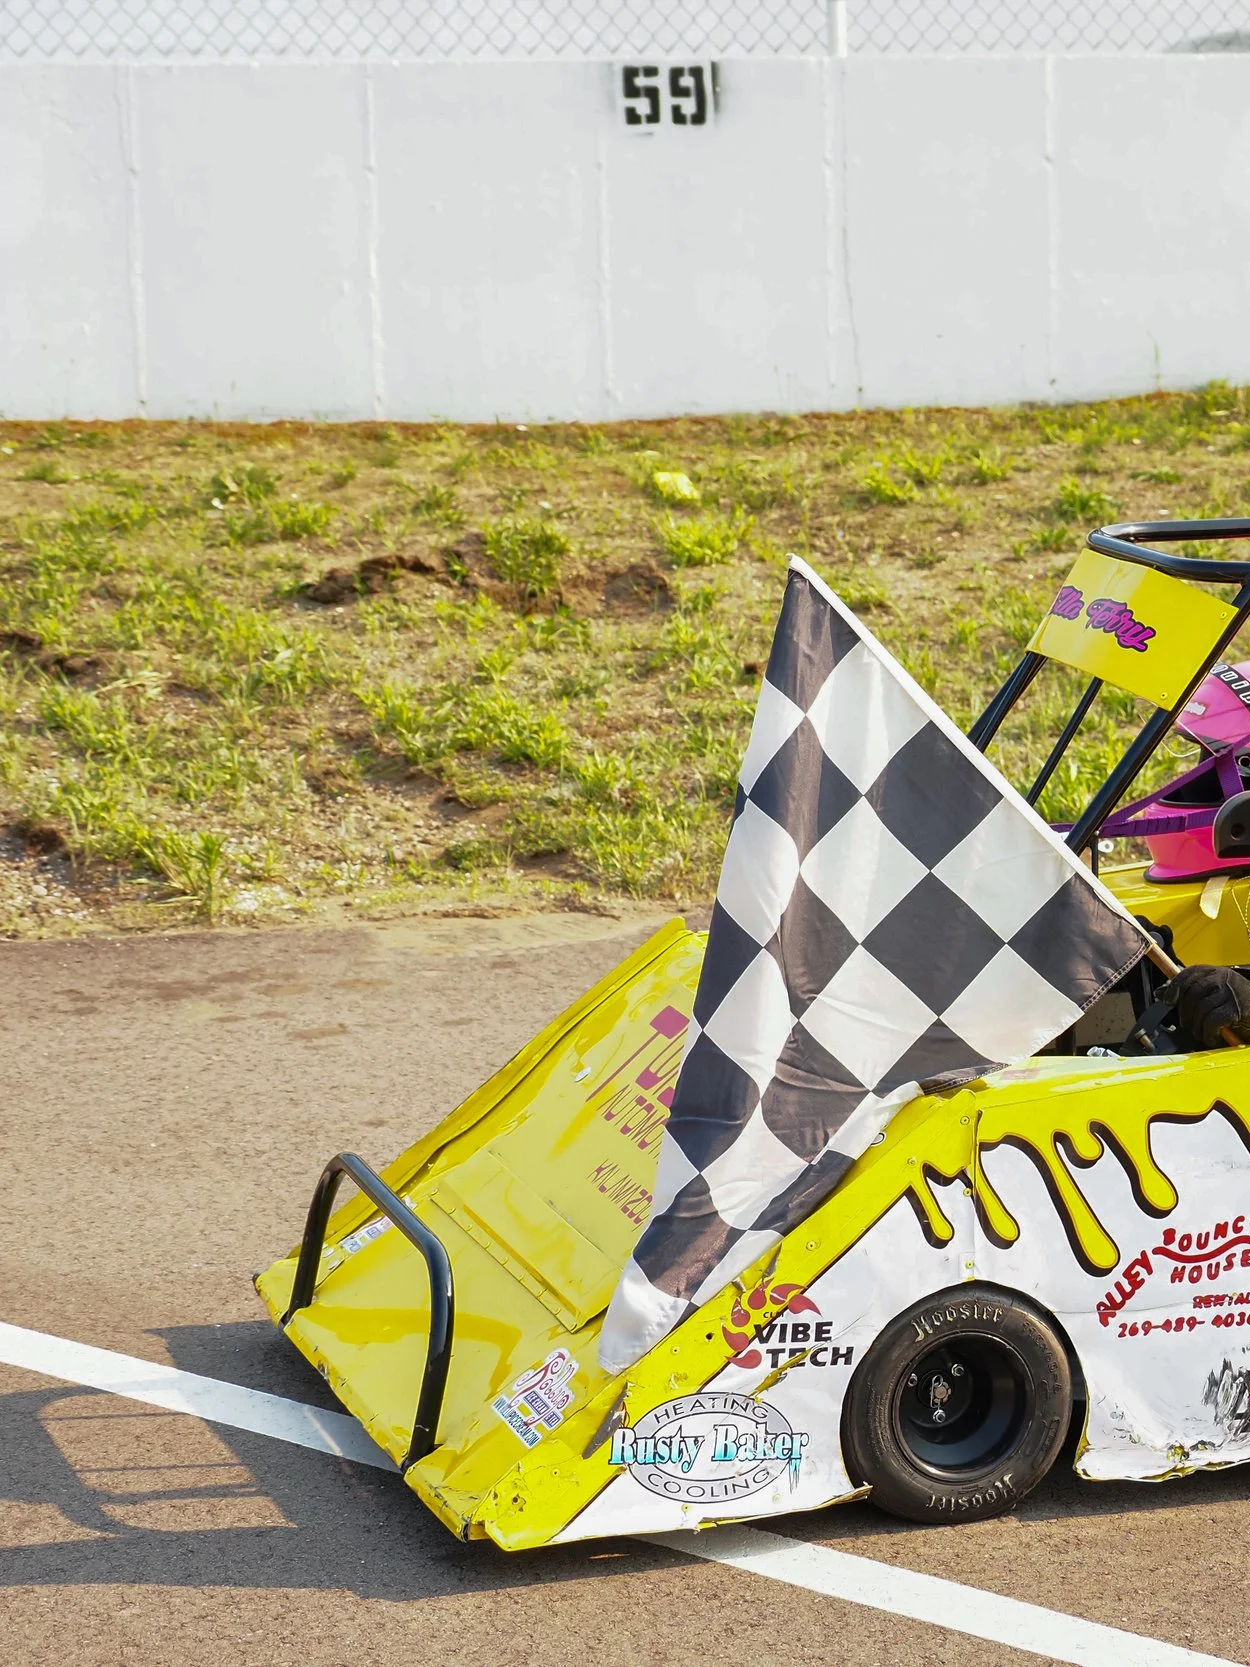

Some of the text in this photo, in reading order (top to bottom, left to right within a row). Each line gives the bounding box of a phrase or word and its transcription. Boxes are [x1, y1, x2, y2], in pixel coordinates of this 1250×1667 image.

[622, 65, 707, 125] 59
[1096, 1250, 1154, 1327] ALLEY
[753, 1321, 834, 1344] VIBE
[911, 1298, 1005, 1343] Hoosier
[765, 1346, 855, 1370] TECH
[653, 1397, 769, 1425] HEATING
[608, 1421, 810, 1474] Rusty Baker
[647, 1468, 771, 1499] COOLING
[924, 1472, 1018, 1511] Hoosier
